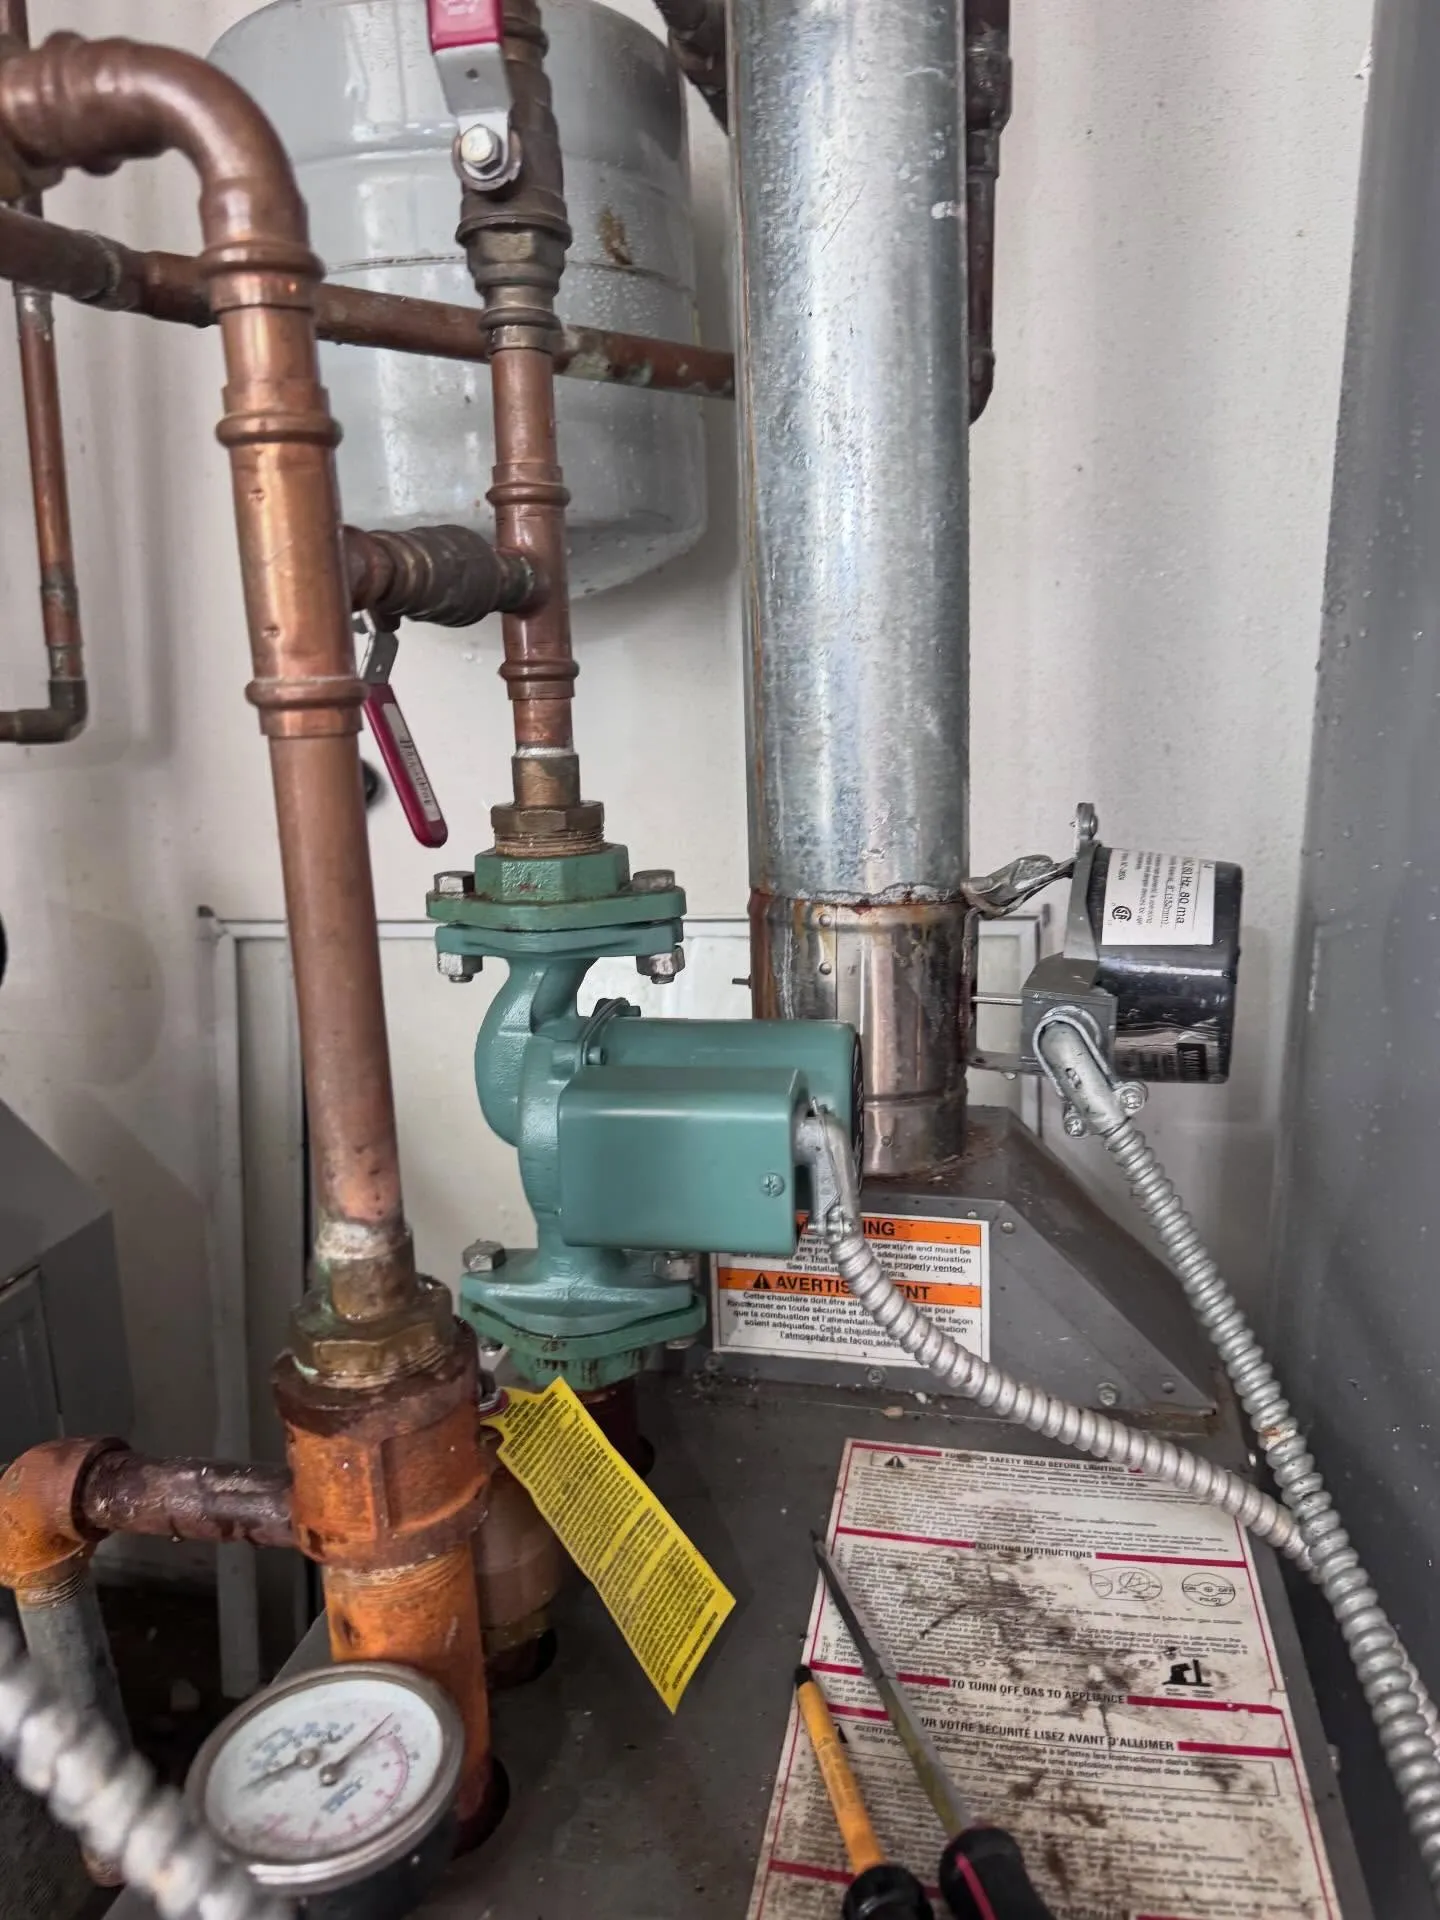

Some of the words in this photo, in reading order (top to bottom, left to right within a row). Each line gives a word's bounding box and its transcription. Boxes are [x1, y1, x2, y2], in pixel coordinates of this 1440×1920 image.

[1176, 907, 1186, 923] ma
[916, 1244, 932, 1252] and
[935, 1245, 957, 1253] must
[959, 1246, 971, 1254] be
[919, 1254, 971, 1263] combustion
[894, 1262, 930, 1272] properly
[934, 1264, 965, 1273] vented.
[811, 1295, 828, 1303] doit
[760, 1312, 810, 1321] combustion
[1024, 1547, 1092, 1559] INSTRUCTIONS
[952, 1680, 964, 1689] TO
[968, 1681, 997, 1692] TURN
[1000, 1685, 1017, 1694] OFF
[1023, 1687, 1044, 1697] GAS
[1048, 1689, 1061, 1698] TO
[921, 1717, 936, 1727] UR
[940, 1720, 974, 1732] VOTRE
[1035, 1730, 1064, 1741] LISEZ
[1068, 1734, 1104, 1745] AVANT
[1109, 1737, 1174, 1751] D'ALLUMER
